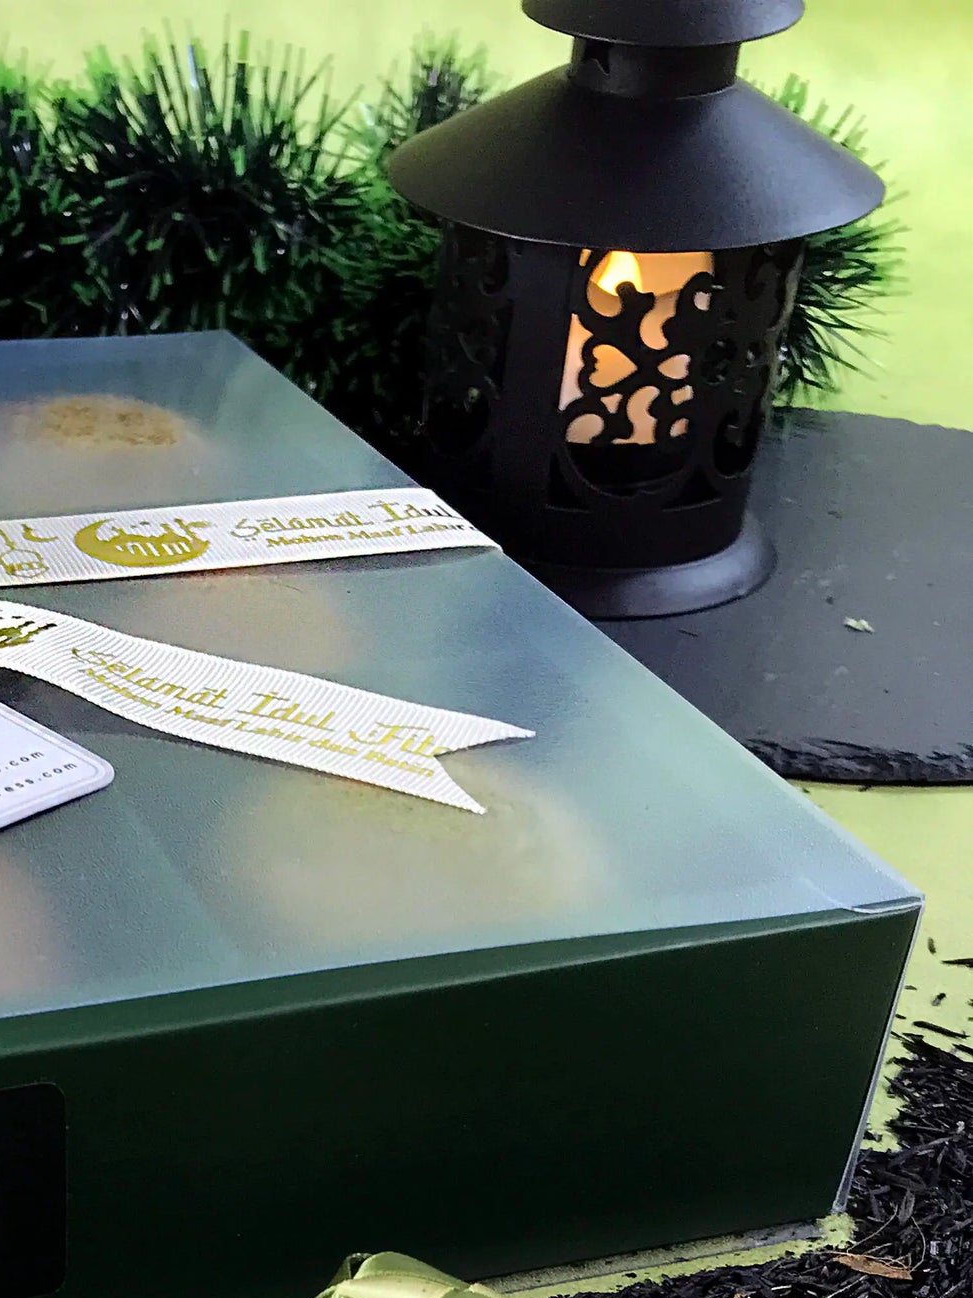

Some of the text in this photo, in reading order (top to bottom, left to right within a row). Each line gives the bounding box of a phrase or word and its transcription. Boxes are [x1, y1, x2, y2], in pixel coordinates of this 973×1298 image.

[230, 500, 464, 543] Selamat Idul
[266, 533, 344, 547] Mohon
[349, 526, 403, 540] Maaf
[71, 648, 451, 758] Selamat Idul Fitr
